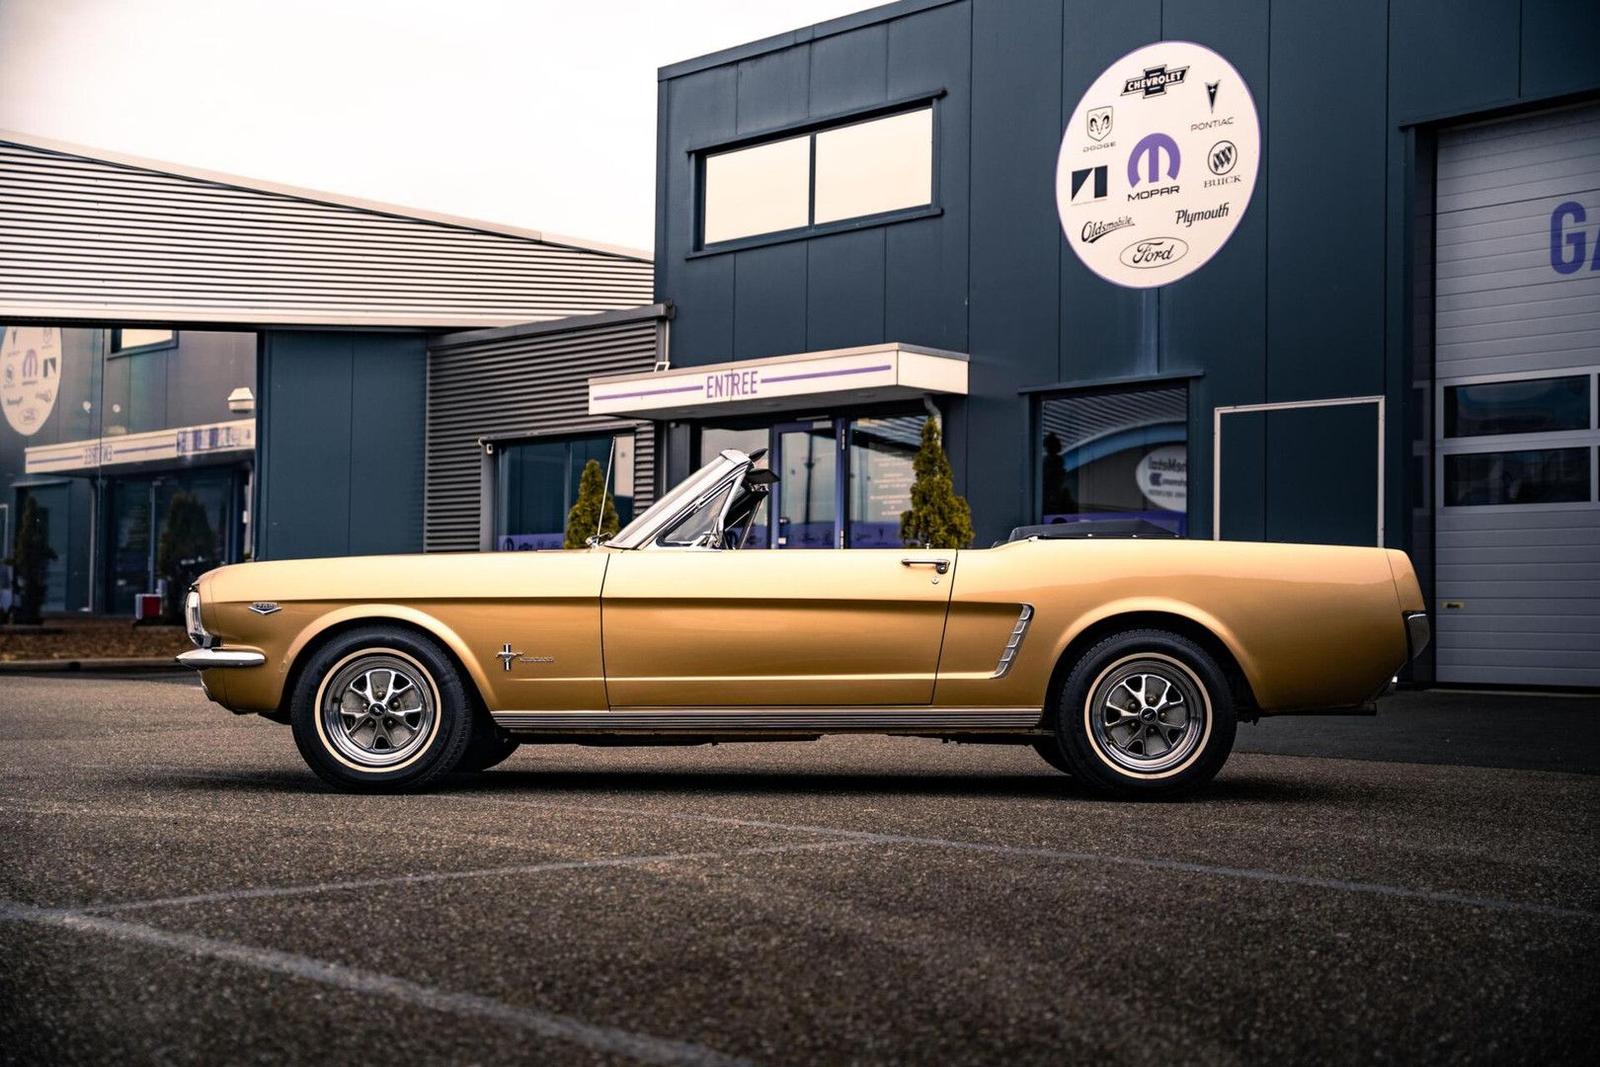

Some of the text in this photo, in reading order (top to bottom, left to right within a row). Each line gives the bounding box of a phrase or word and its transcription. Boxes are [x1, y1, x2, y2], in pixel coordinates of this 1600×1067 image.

[1128, 71, 1182, 91] CHEVROLET
[1191, 117, 1234, 131] PONTIAC
[1083, 142, 1116, 153] DODGE
[1204, 175, 1241, 188] BUICK
[1128, 185, 1180, 201] MOPAR
[1176, 202, 1229, 227] Plymouth
[1081, 217, 1135, 243] Oldsmobile
[1552, 202, 1600, 275] G
[1132, 242, 1174, 263] Ford
[707, 371, 758, 398] ENTREE
